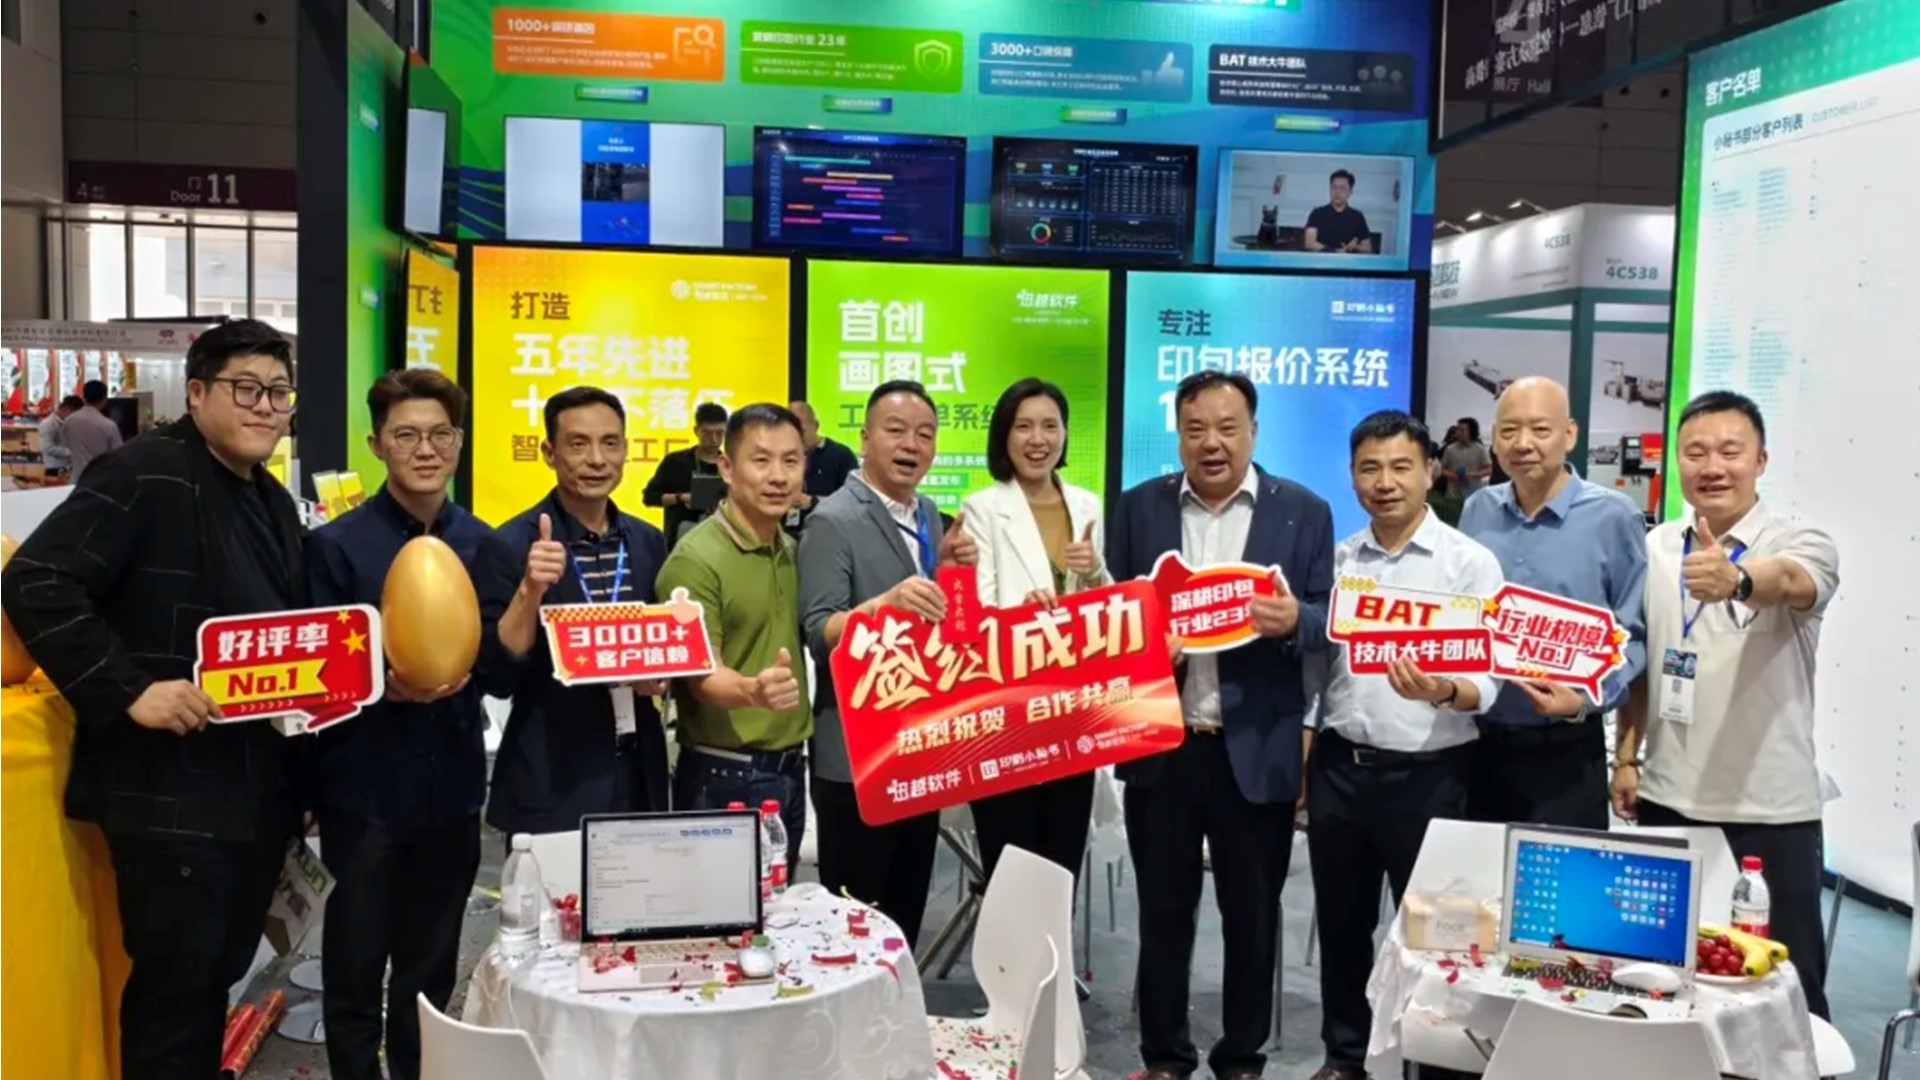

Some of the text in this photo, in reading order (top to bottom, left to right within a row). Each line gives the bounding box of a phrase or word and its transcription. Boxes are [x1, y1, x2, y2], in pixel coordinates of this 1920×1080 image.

[1219, 53, 1246, 67] BAT
[1705, 67, 1762, 107] 客户名单
[170, 173, 239, 203] Door 11
[1606, 265, 1659, 280] 4C538
[511, 291, 570, 321] 打造
[839, 300, 924, 343] 首创
[1157, 309, 1212, 337] 专注
[510, 332, 691, 380] 五年先进
[838, 351, 967, 393] 画图式
[1157, 344, 1390, 388] 印包报价系统
[1354, 594, 1442, 627] BAT
[217, 623, 329, 662] 好评率
[567, 622, 690, 648] 3000+
[1498, 608, 1605, 650] 行业规模
[595, 646, 690, 669] 客户信赖
[850, 593, 1146, 712] 签约成功
[1353, 637, 1487, 664] 技术大牛团队
[1516, 637, 1575, 666] No.1
[226, 667, 298, 698] No.1
[896, 675, 1134, 756] 热烈祝贺 合作共赢
